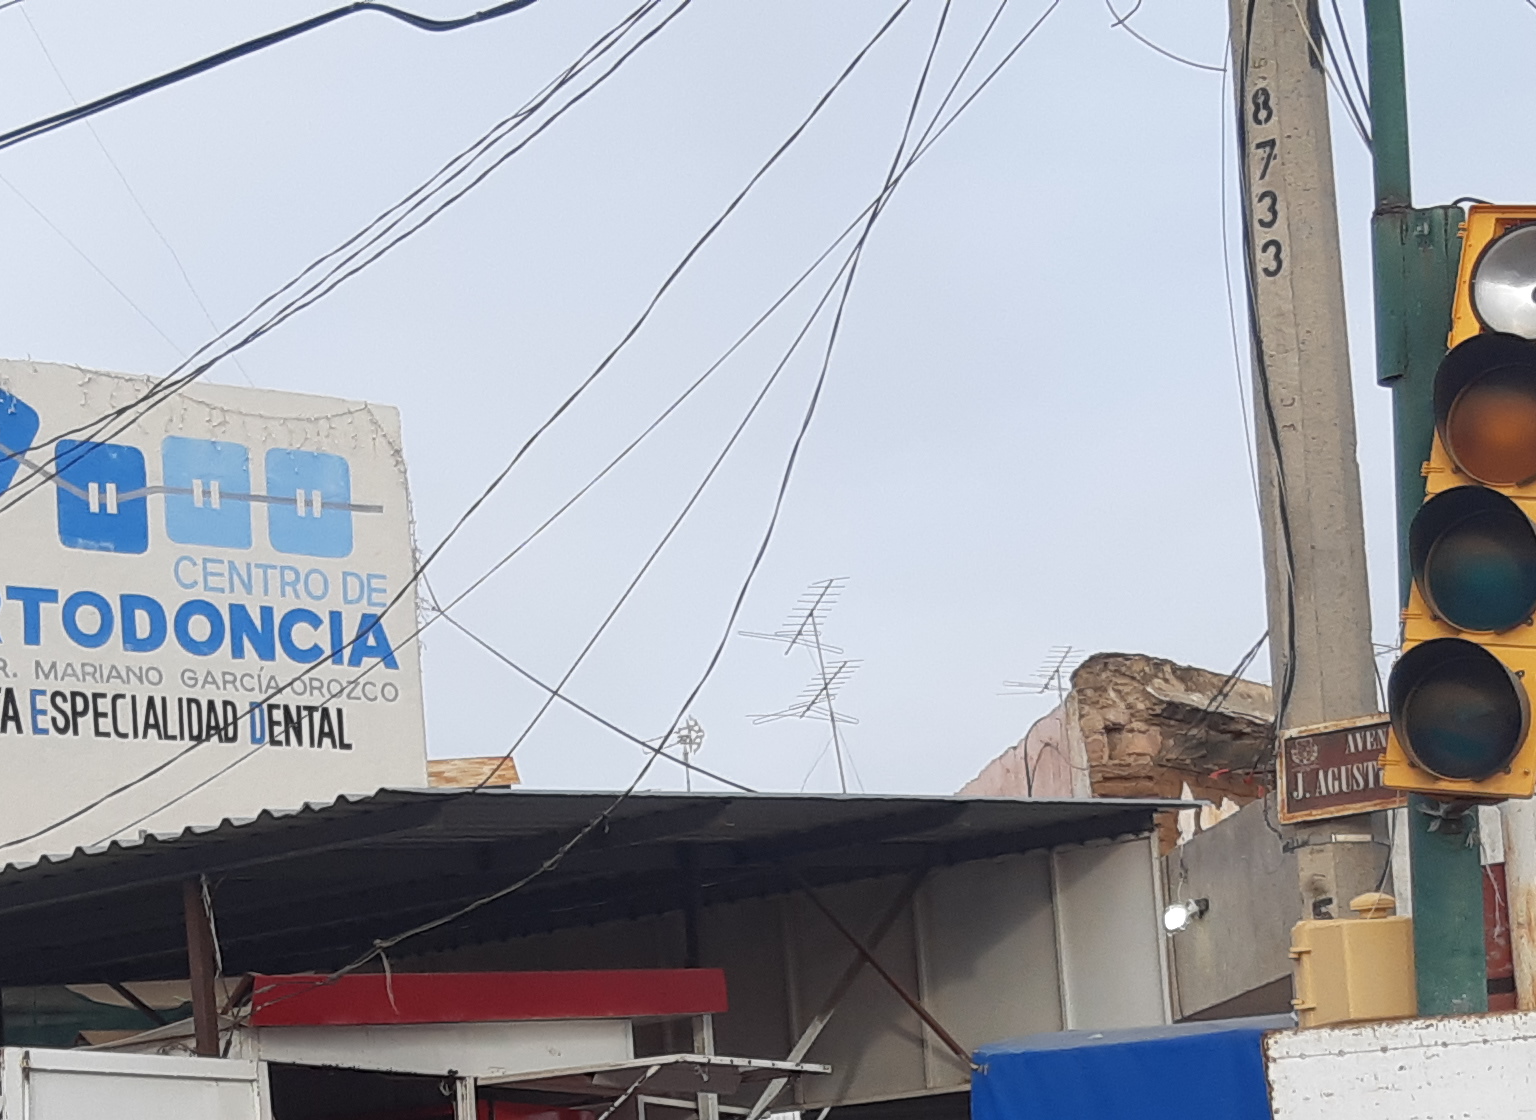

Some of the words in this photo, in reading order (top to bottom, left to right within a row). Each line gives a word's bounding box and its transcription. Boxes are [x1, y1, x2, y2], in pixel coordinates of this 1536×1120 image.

[173, 555, 330, 602] CENTRO
[340, 573, 388, 608] DE
[34, 659, 163, 688] MARIANO
[180, 664, 281, 695] GARCÍA
[290, 677, 400, 704] OROZCO
[31, 687, 239, 745] ESPECIALIDAD
[249, 700, 354, 751] DENTAL
[1344, 725, 1389, 756] AVEN
[1291, 771, 1312, 801] J.
[1315, 760, 1385, 798] AGUST
